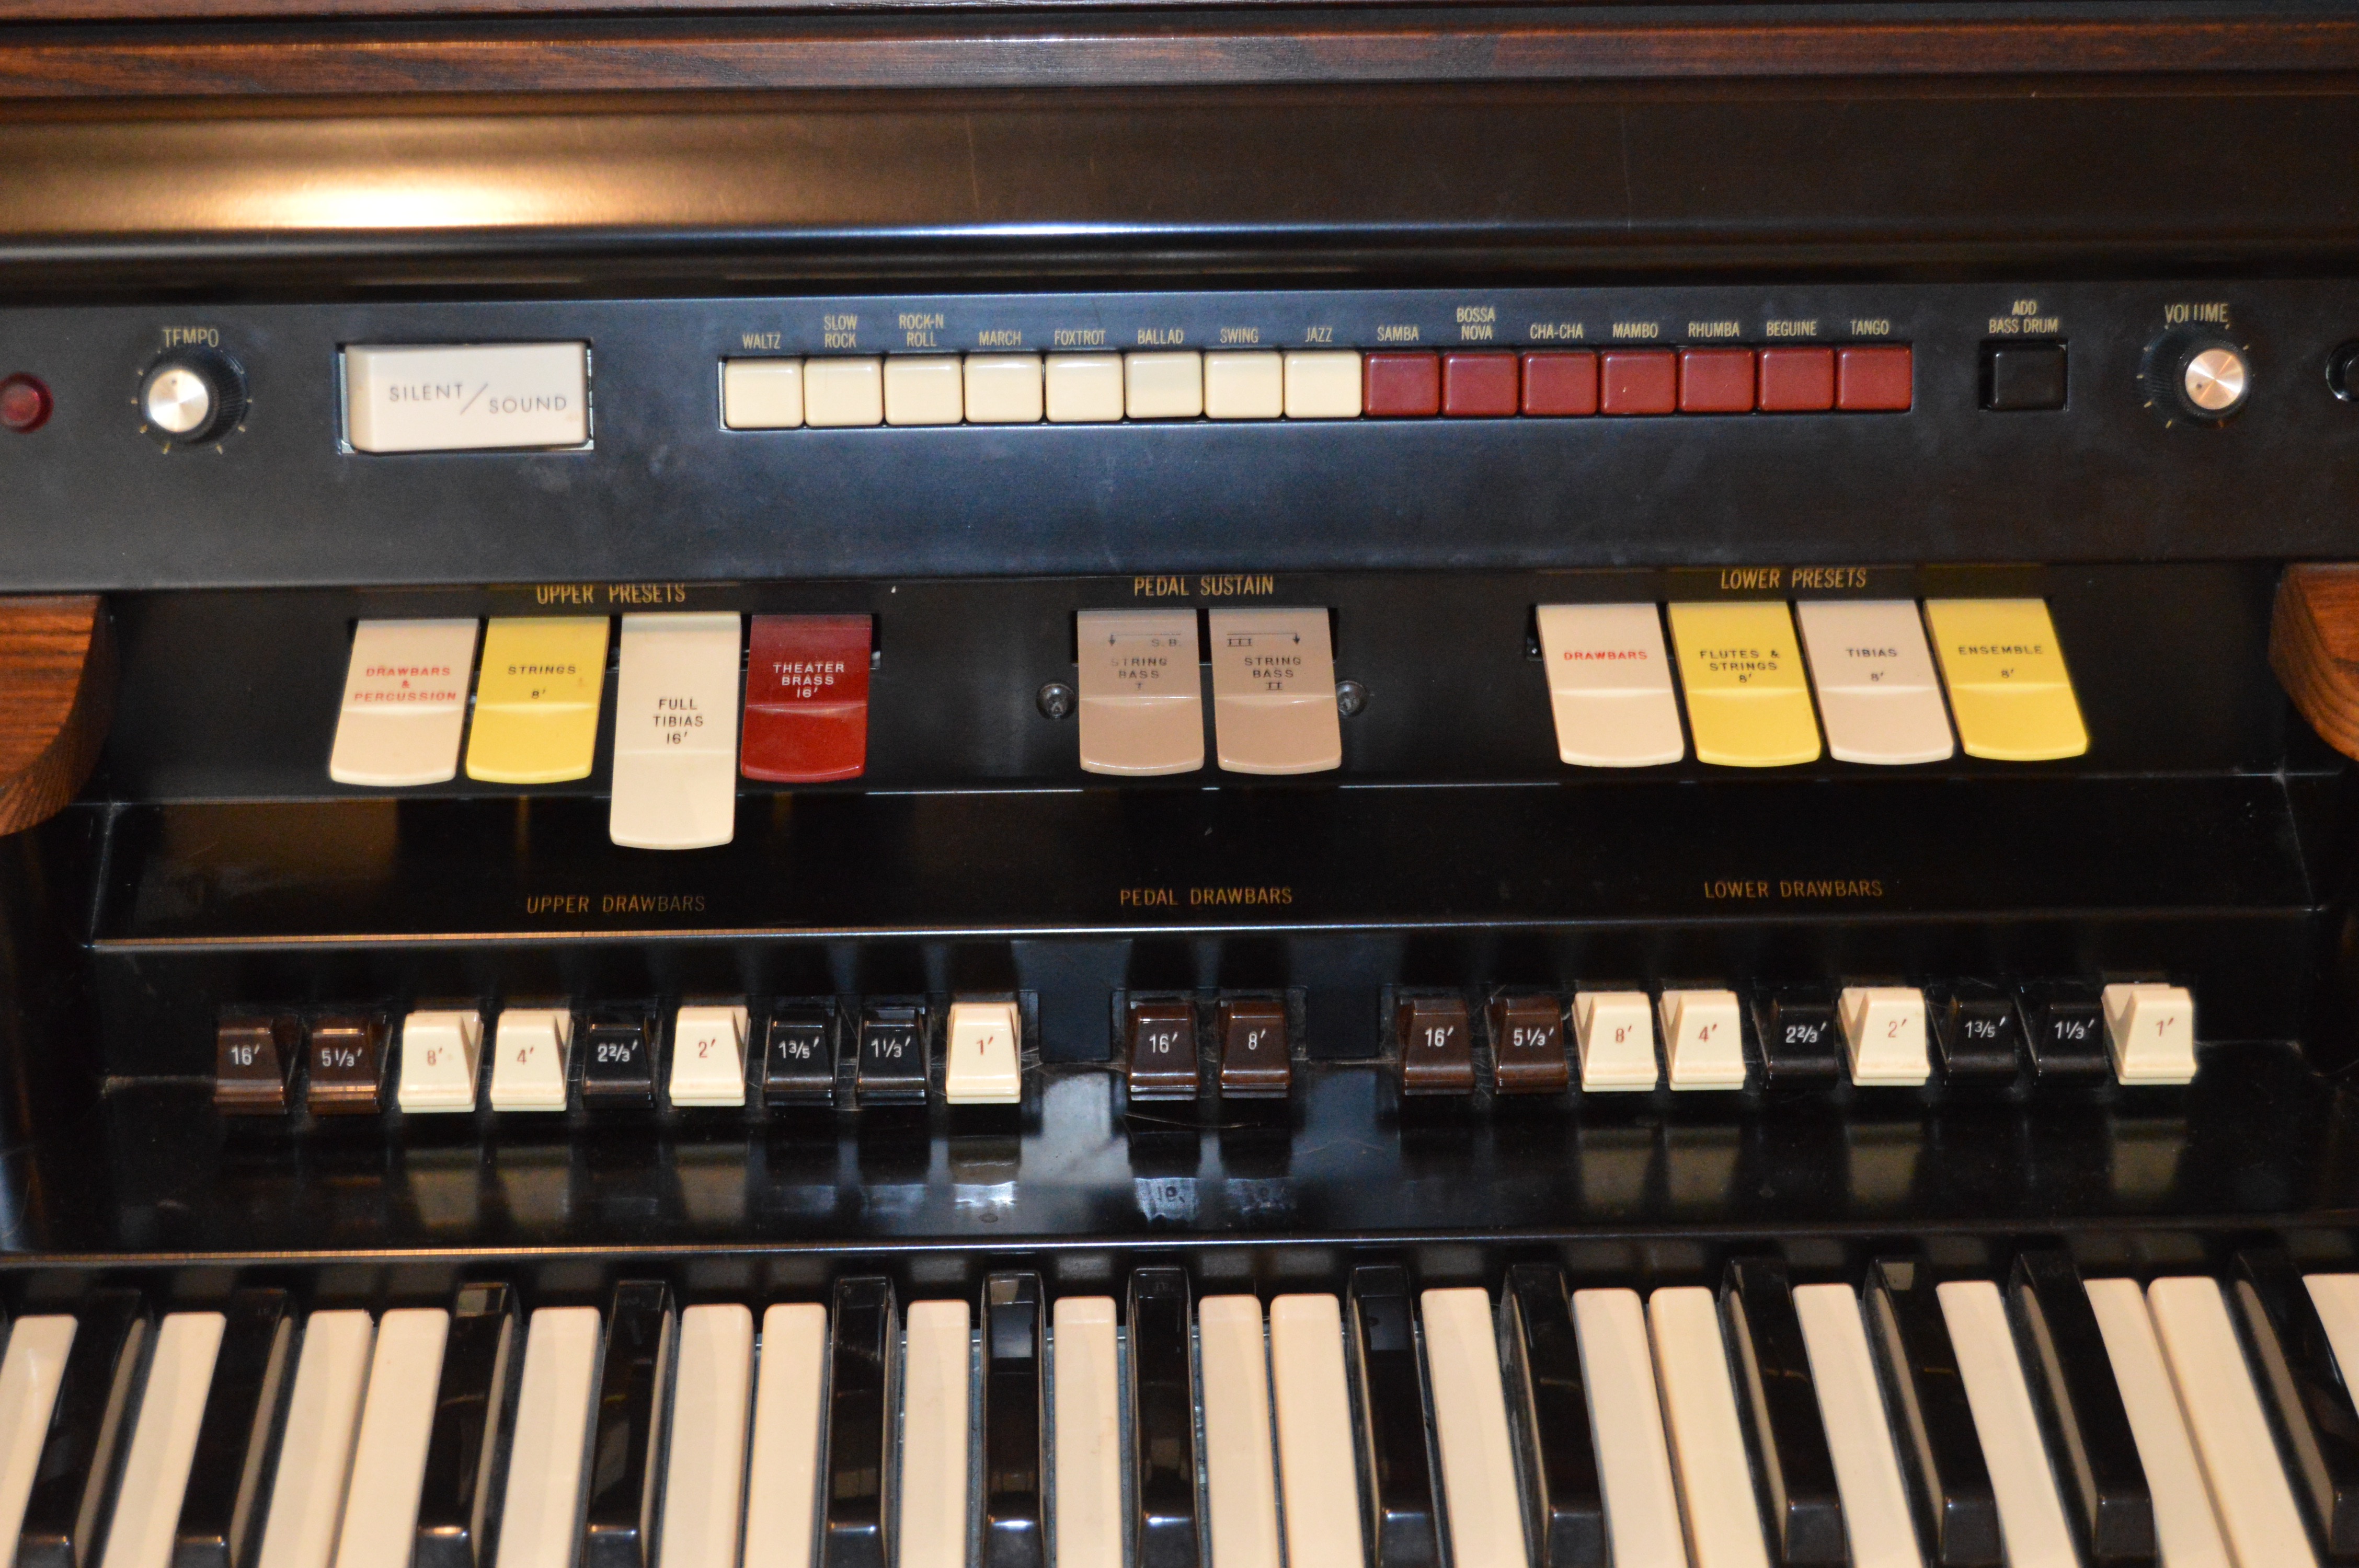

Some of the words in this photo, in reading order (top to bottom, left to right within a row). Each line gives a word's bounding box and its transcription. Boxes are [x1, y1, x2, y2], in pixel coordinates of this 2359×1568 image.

[1457, 307, 1495, 322] BOSSA
[2012, 301, 2037, 316] ADD
[824, 315, 857, 331] SLOW
[899, 314, 944, 329] ROCK-N
[1688, 321, 1740, 337] RHUMBA
[1766, 320, 1817, 336] BEGUINE
[1850, 320, 1889, 336] TANGO
[1989, 318, 2019, 333] BASS
[2023, 318, 2058, 333] DRUM
[163, 328, 219, 348] TEMPO
[1054, 330, 1106, 345] FOXTROT
[1138, 329, 1184, 344] BALLAD
[1220, 328, 1259, 344] SWING
[1305, 327, 1332, 343] JAZZ
[1377, 326, 1419, 341] SAMBA
[1461, 325, 1493, 340] NOVA
[1530, 324, 1583, 339] CHA-CHA
[1612, 323, 1658, 338] MAMBO
[743, 333, 781, 349] WALTZ
[824, 332, 856, 348] ROCK
[907, 331, 937, 347] ROLL
[979, 331, 1021, 346] MARCH
[1135, 577, 1189, 596] PEDAL
[1200, 575, 1274, 596] SUSTAIN
[1721, 568, 1780, 590] LOWER
[1792, 568, 1866, 589] PRESETS
[537, 584, 594, 605] UPPER
[608, 583, 685, 604] PRESETS
[1564, 650, 1648, 661] DRAWBARS
[1700, 649, 1760, 660] FLUTES
[1770, 649, 1781, 659] &
[1846, 648, 1898, 658] TIBIAS
[1959, 645, 2043, 655] ENSEMBLE
[773, 662, 845, 674] THEATER
[1111, 658, 1167, 666] STRING
[1245, 657, 1301, 666] STRING
[1710, 662, 1778, 671] STRINGS
[366, 666, 451, 677] DRAWBARS
[508, 665, 577, 675] STRINGS
[1119, 670, 1159, 679] BASS
[1253, 670, 1294, 678] BASS
[1871, 672, 1884, 682] 8'
[2001, 668, 2015, 679] 8'
[402, 680, 410, 688] &
[782, 675, 834, 686] BRASS
[1265, 681, 1282, 691] II
[354, 691, 456, 703] PERCUSSION
[531, 688, 546, 700] 8'
[796, 687, 819, 699] 16'
[659, 698, 697, 711] FULL
[653, 715, 704, 728] TIBIAS
[666, 731, 688, 745] 16'
[1120, 887, 1178, 906] PEDAL
[1190, 886, 1292, 905] DRAWBARS
[1704, 880, 1769, 898] LOWER
[1780, 879, 1883, 897] DRAWBARS
[526, 894, 589, 914] UPPER
[602, 894, 705, 913] DRAWBARS
[1615, 1025, 1633, 1044] 8'
[1698, 1023, 1718, 1043] 4'
[1887, 1018, 1907, 1039] 2'
[2155, 1017, 2174, 1037] 1'
[1149, 1031, 1178, 1054] 16'
[1247, 1028, 1266, 1051] 8'
[1424, 1025, 1454, 1047] 16'
[698, 1038, 716, 1058] 2'
[977, 1036, 994, 1055] 1'
[231, 1044, 260, 1066] 16'
[427, 1047, 443, 1066] 8'
[517, 1046, 534, 1066] 4'
